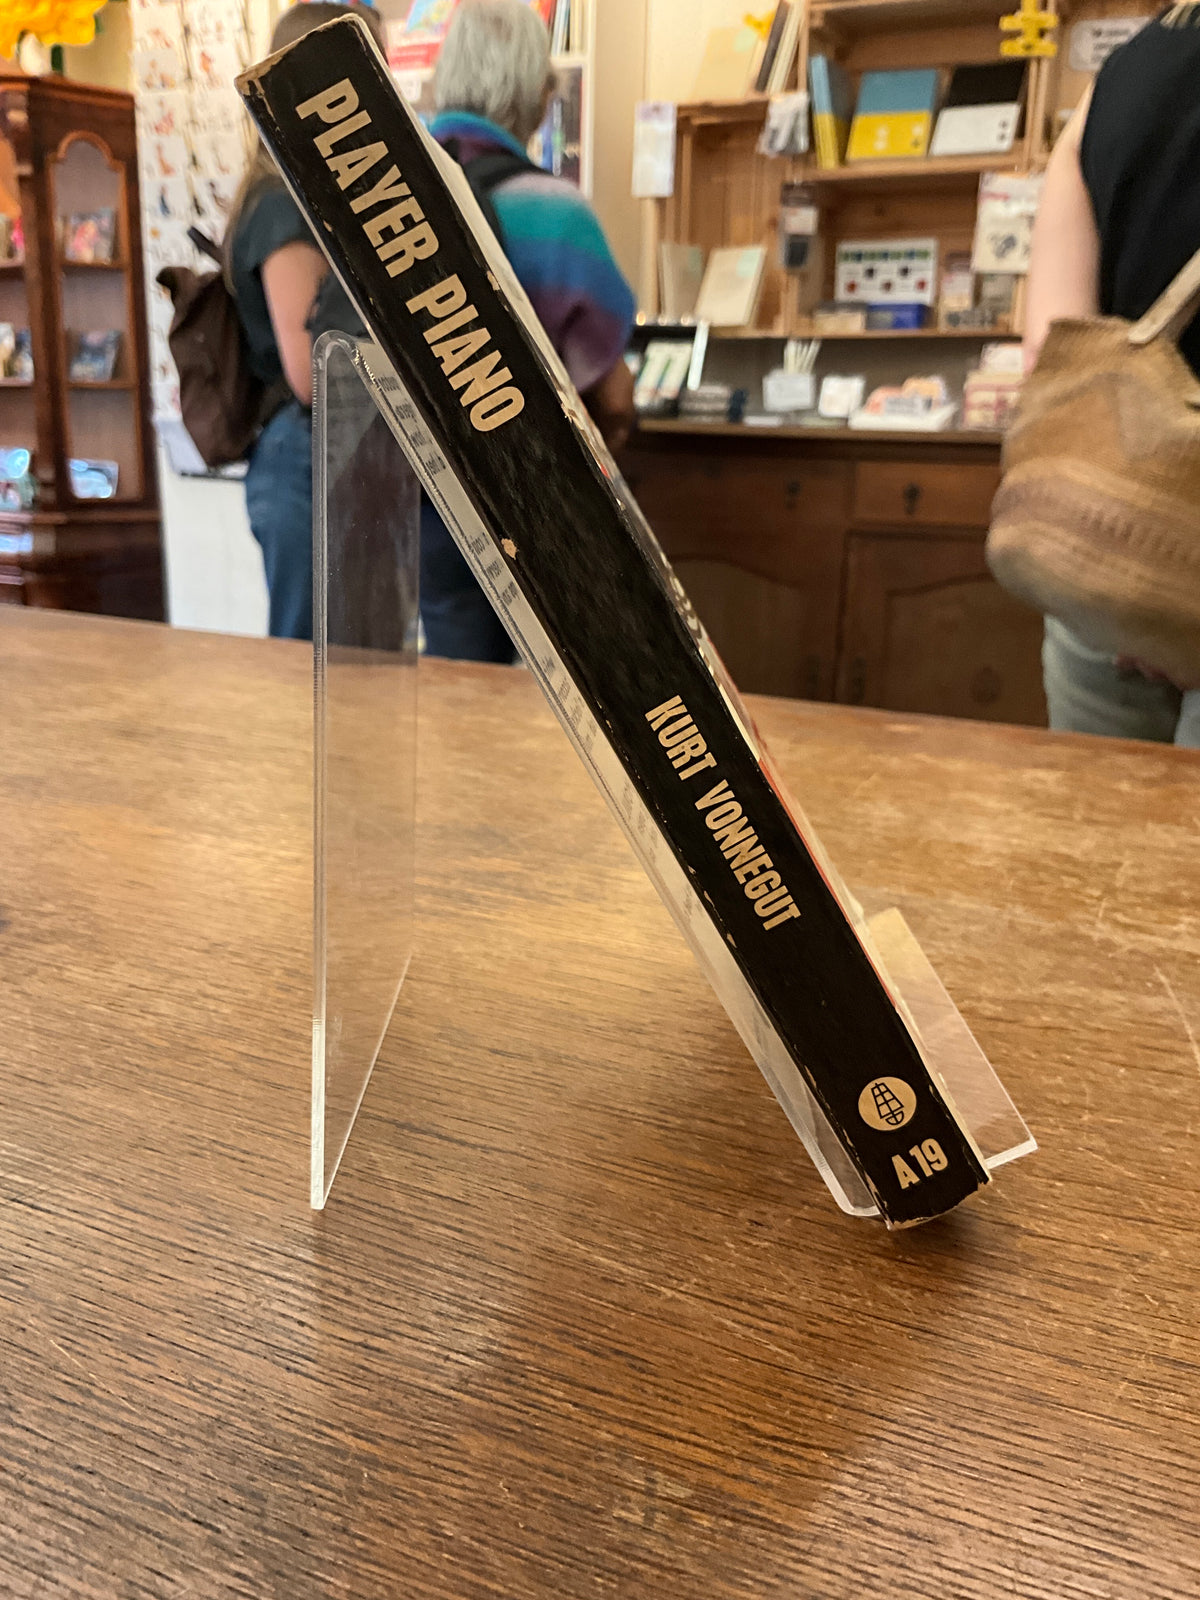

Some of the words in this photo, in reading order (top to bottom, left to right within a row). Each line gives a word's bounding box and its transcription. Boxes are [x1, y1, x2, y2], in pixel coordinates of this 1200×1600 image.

[296, 78, 438, 277] PLAYER
[406, 274, 524, 431] PIANO
[645, 695, 717, 780] KURT
[695, 779, 801, 930] VONNEGUT
[892, 1154, 920, 1189] A
[909, 1138, 949, 1177] 19
